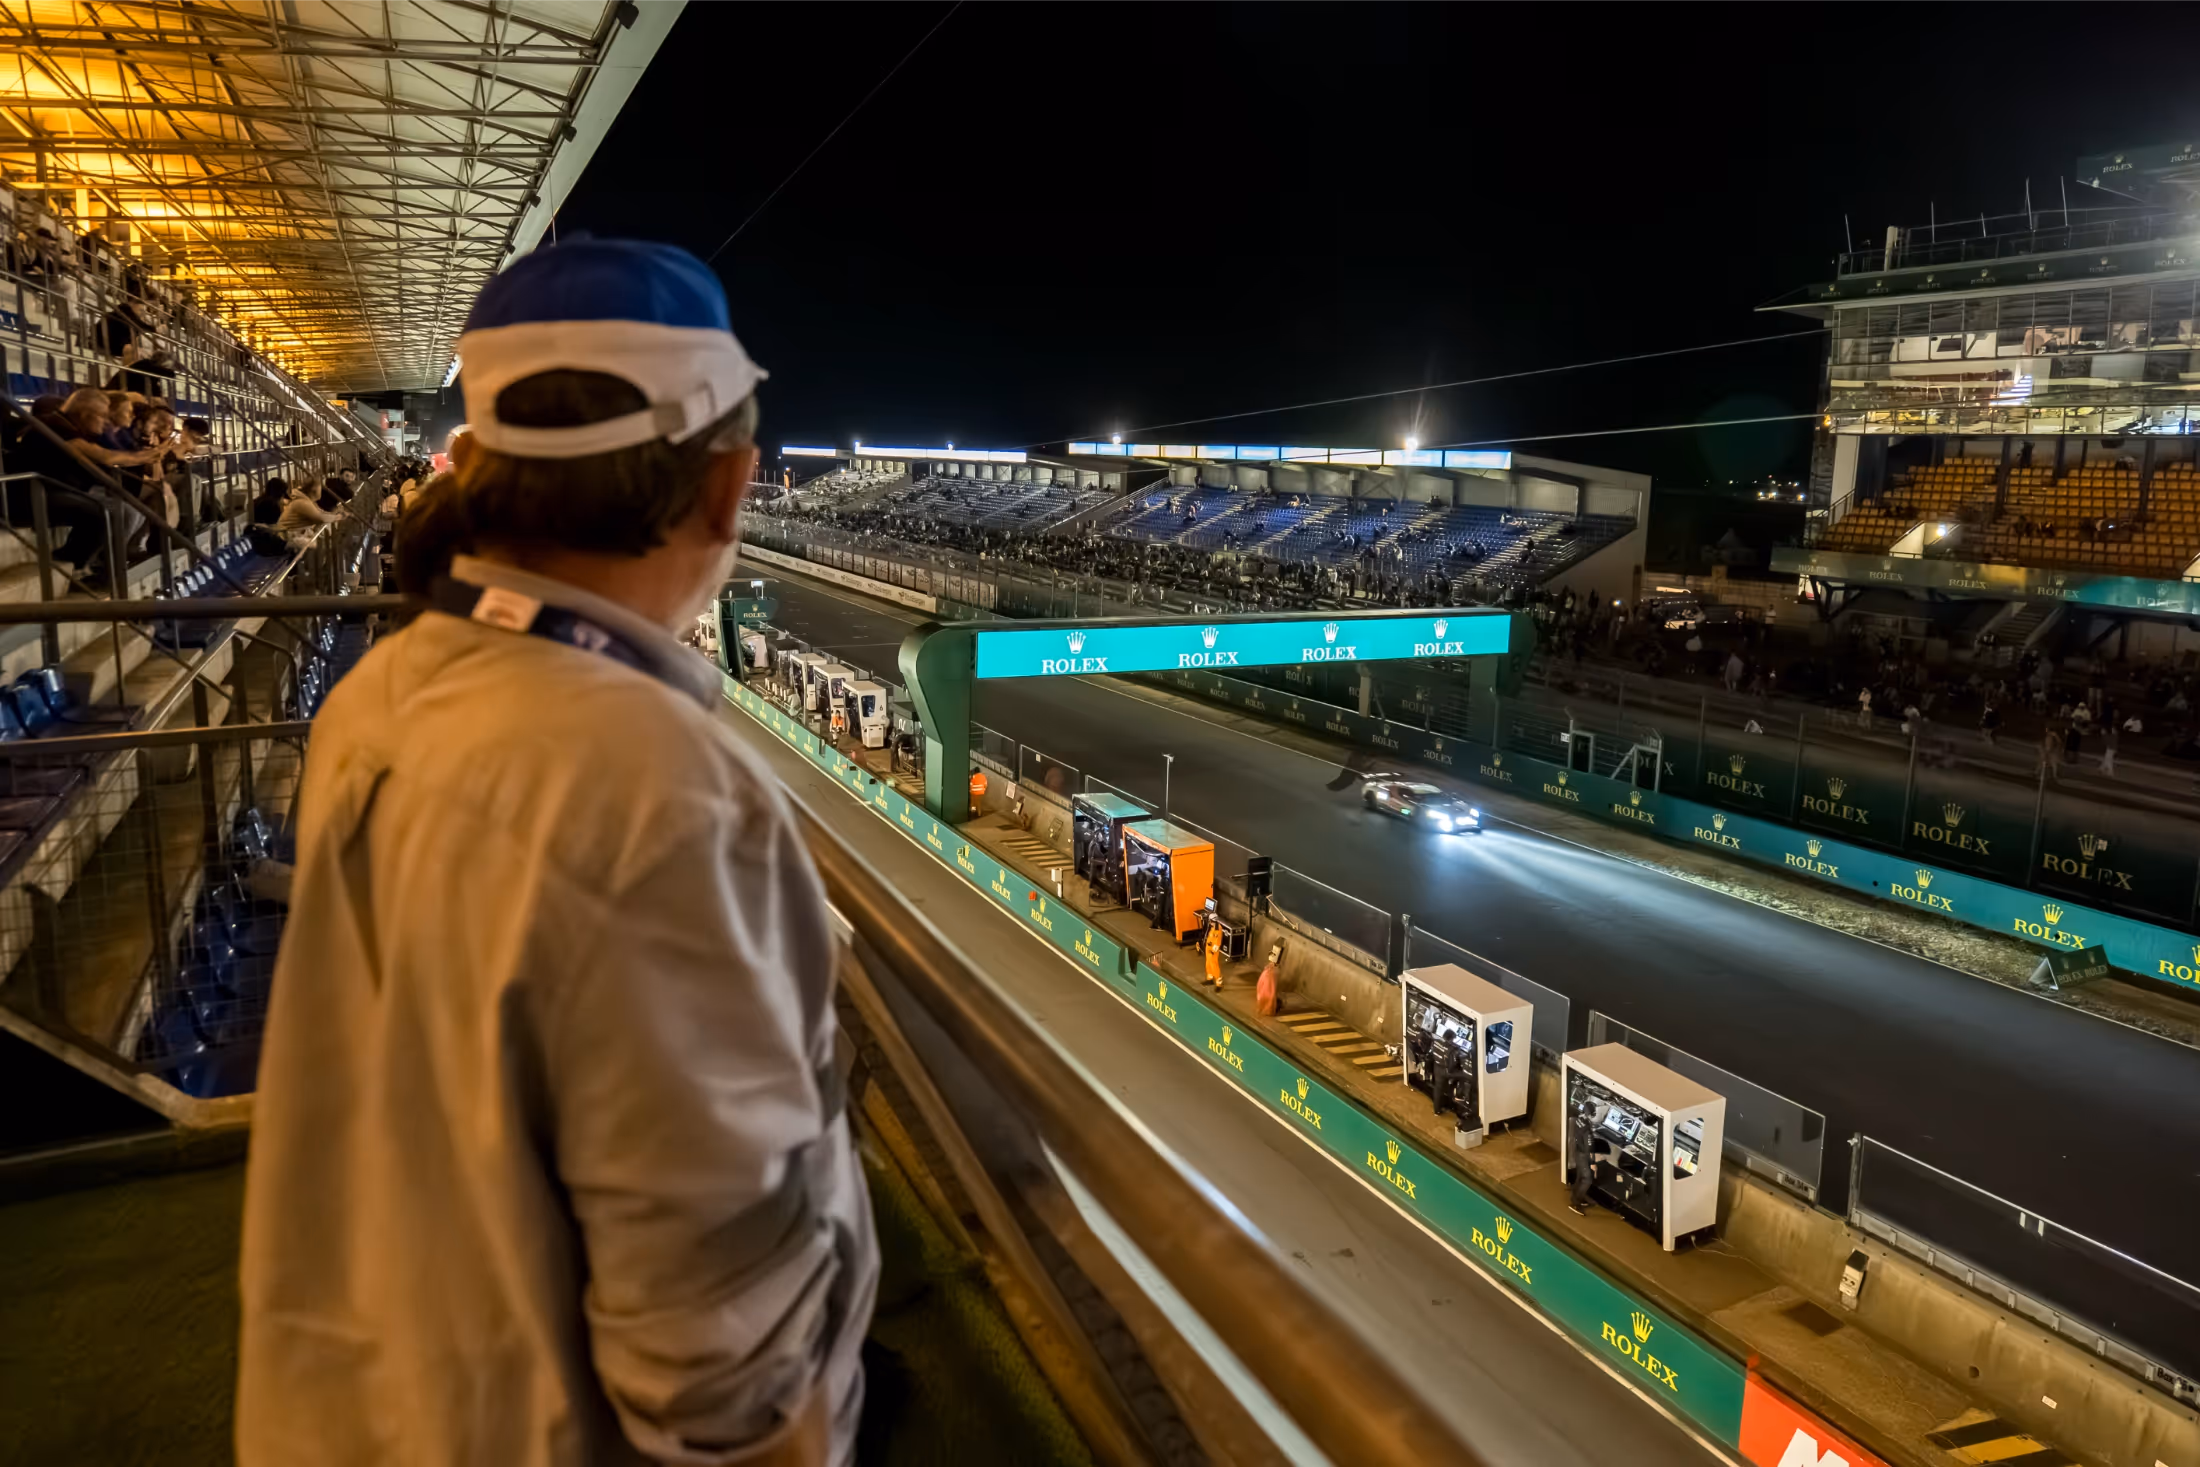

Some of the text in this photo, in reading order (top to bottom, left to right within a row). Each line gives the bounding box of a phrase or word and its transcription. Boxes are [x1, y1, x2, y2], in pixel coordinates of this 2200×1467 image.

[2103, 163, 2133, 174] ROLEX
[1869, 571, 1904, 582] ROLEX
[1949, 578, 1988, 590] ROLEX
[2037, 586, 2081, 599] ROLEX
[1178, 651, 1239, 669] ROLEX
[1302, 646, 1357, 662] ROLEX
[1413, 641, 1465, 656] ROLEX
[1041, 657, 1109, 675] ROLEX
[1372, 734, 1400, 750] ROLEX
[1480, 764, 1513, 783] ROLEX
[1707, 770, 1765, 798] ROLEX
[1543, 783, 1580, 802] ROLEX
[1614, 803, 1655, 825] ROLEX
[1802, 794, 1870, 825] ROLEX
[1694, 826, 1741, 850] ROLEX
[1912, 821, 1992, 857] ROLEX
[957, 855, 975, 874] ROLEX
[1785, 852, 1839, 879] ROLEX
[991, 880, 1011, 901] ROLEX
[1890, 883, 1954, 913] ROLEX
[1031, 907, 1053, 932] ROLEX
[2013, 918, 2087, 950] ROLEX
[1075, 940, 1100, 966] ROLEX
[1147, 991, 1177, 1023] ROLEX
[1208, 1036, 1244, 1073] ROLEX
[1280, 1088, 1322, 1131] ROLEX
[1366, 1151, 1417, 1200] ROLEX
[1471, 1227, 1532, 1285] ROLEX
[1602, 1320, 1678, 1392] ROLEX
